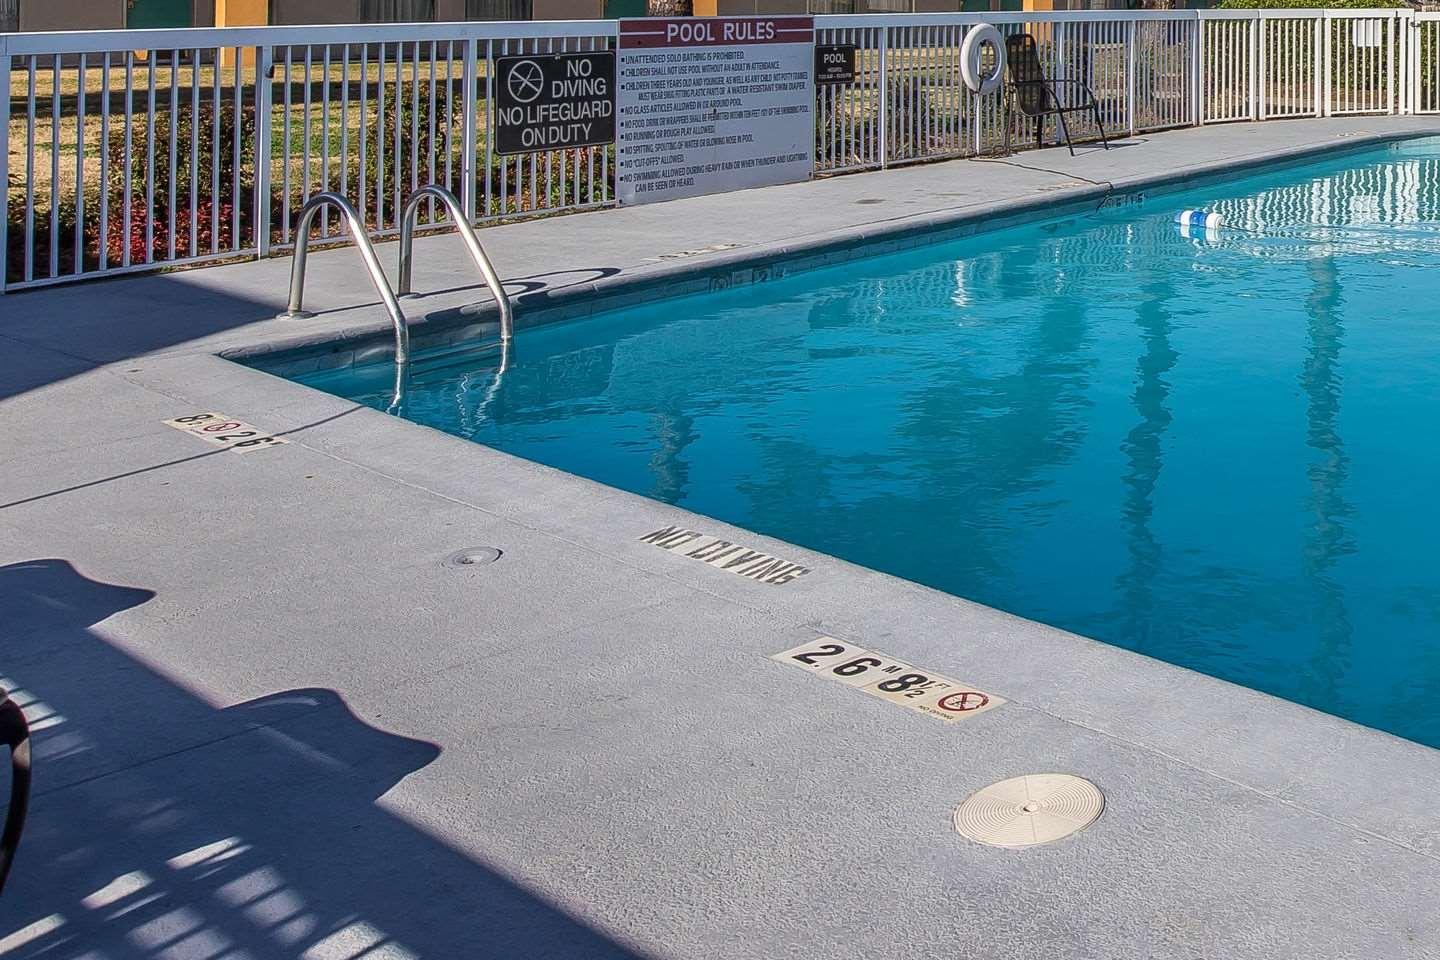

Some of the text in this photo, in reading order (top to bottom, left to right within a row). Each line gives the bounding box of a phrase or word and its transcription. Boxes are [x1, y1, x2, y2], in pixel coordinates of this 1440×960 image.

[667, 21, 775, 42] POOL RULES
[625, 54, 665, 63] UNATTENDED
[666, 53, 681, 62] SOLO
[682, 53, 705, 61] BATHING
[706, 52, 711, 60] IS
[823, 53, 847, 63] POOL
[567, 59, 592, 77] NO
[625, 67, 650, 76] CHILDREN
[650, 67, 665, 75] SHALL
[667, 66, 677, 74] NOT
[678, 66, 687, 74] USE
[688, 65, 700, 73] POOL
[701, 64, 723, 72] WITHOUT
[552, 77, 607, 98] DIVING
[625, 80, 649, 90] CHILDREN
[666, 78, 682, 88] YEARS
[682, 78, 691, 87] OLD
[692, 77, 702, 86] AND
[732, 75, 744, 84] WELL
[759, 74, 772, 82] CHILD
[731, 86, 748, 94] WATER
[749, 84, 774, 93] RESISTANT
[498, 99, 612, 127] NO LIFEGUARD
[624, 105, 632, 114] NO
[633, 104, 649, 114] GLASS
[650, 102, 672, 112] ARTICLES
[673, 101, 696, 111] ALLOWED
[696, 100, 701, 109] IN
[624, 119, 631, 128] NO
[522, 123, 592, 147] ON DUTY
[624, 132, 632, 141] NO
[633, 130, 654, 140] RUNNING
[655, 129, 663, 138] OR
[663, 128, 680, 137] ROUGH
[680, 127, 692, 135] PLAY
[625, 145, 632, 154] NO
[684, 139, 698, 148] WATER
[699, 138, 704, 147] OR
[725, 135, 736, 144] NOSE
[737, 135, 741, 143] IN
[623, 173, 632, 182] NO
[633, 170, 661, 181] SWIMMING
[661, 167, 685, 178] ALLOWED
[686, 165, 704, 175] DURING
[705, 163, 720, 172] HEAVY
[721, 162, 733, 171] RAIN
[733, 161, 740, 169] OR
[740, 159, 753, 168] WHEN
[754, 157, 776, 167] THUNDER
[776, 156, 785, 164] AND
[624, 159, 632, 168] NO
[634, 183, 646, 192] CAN
[647, 182, 654, 190] BE
[655, 180, 667, 189] SEEN
[668, 179, 675, 188] OR
[639, 526, 811, 585] NO DIVING
